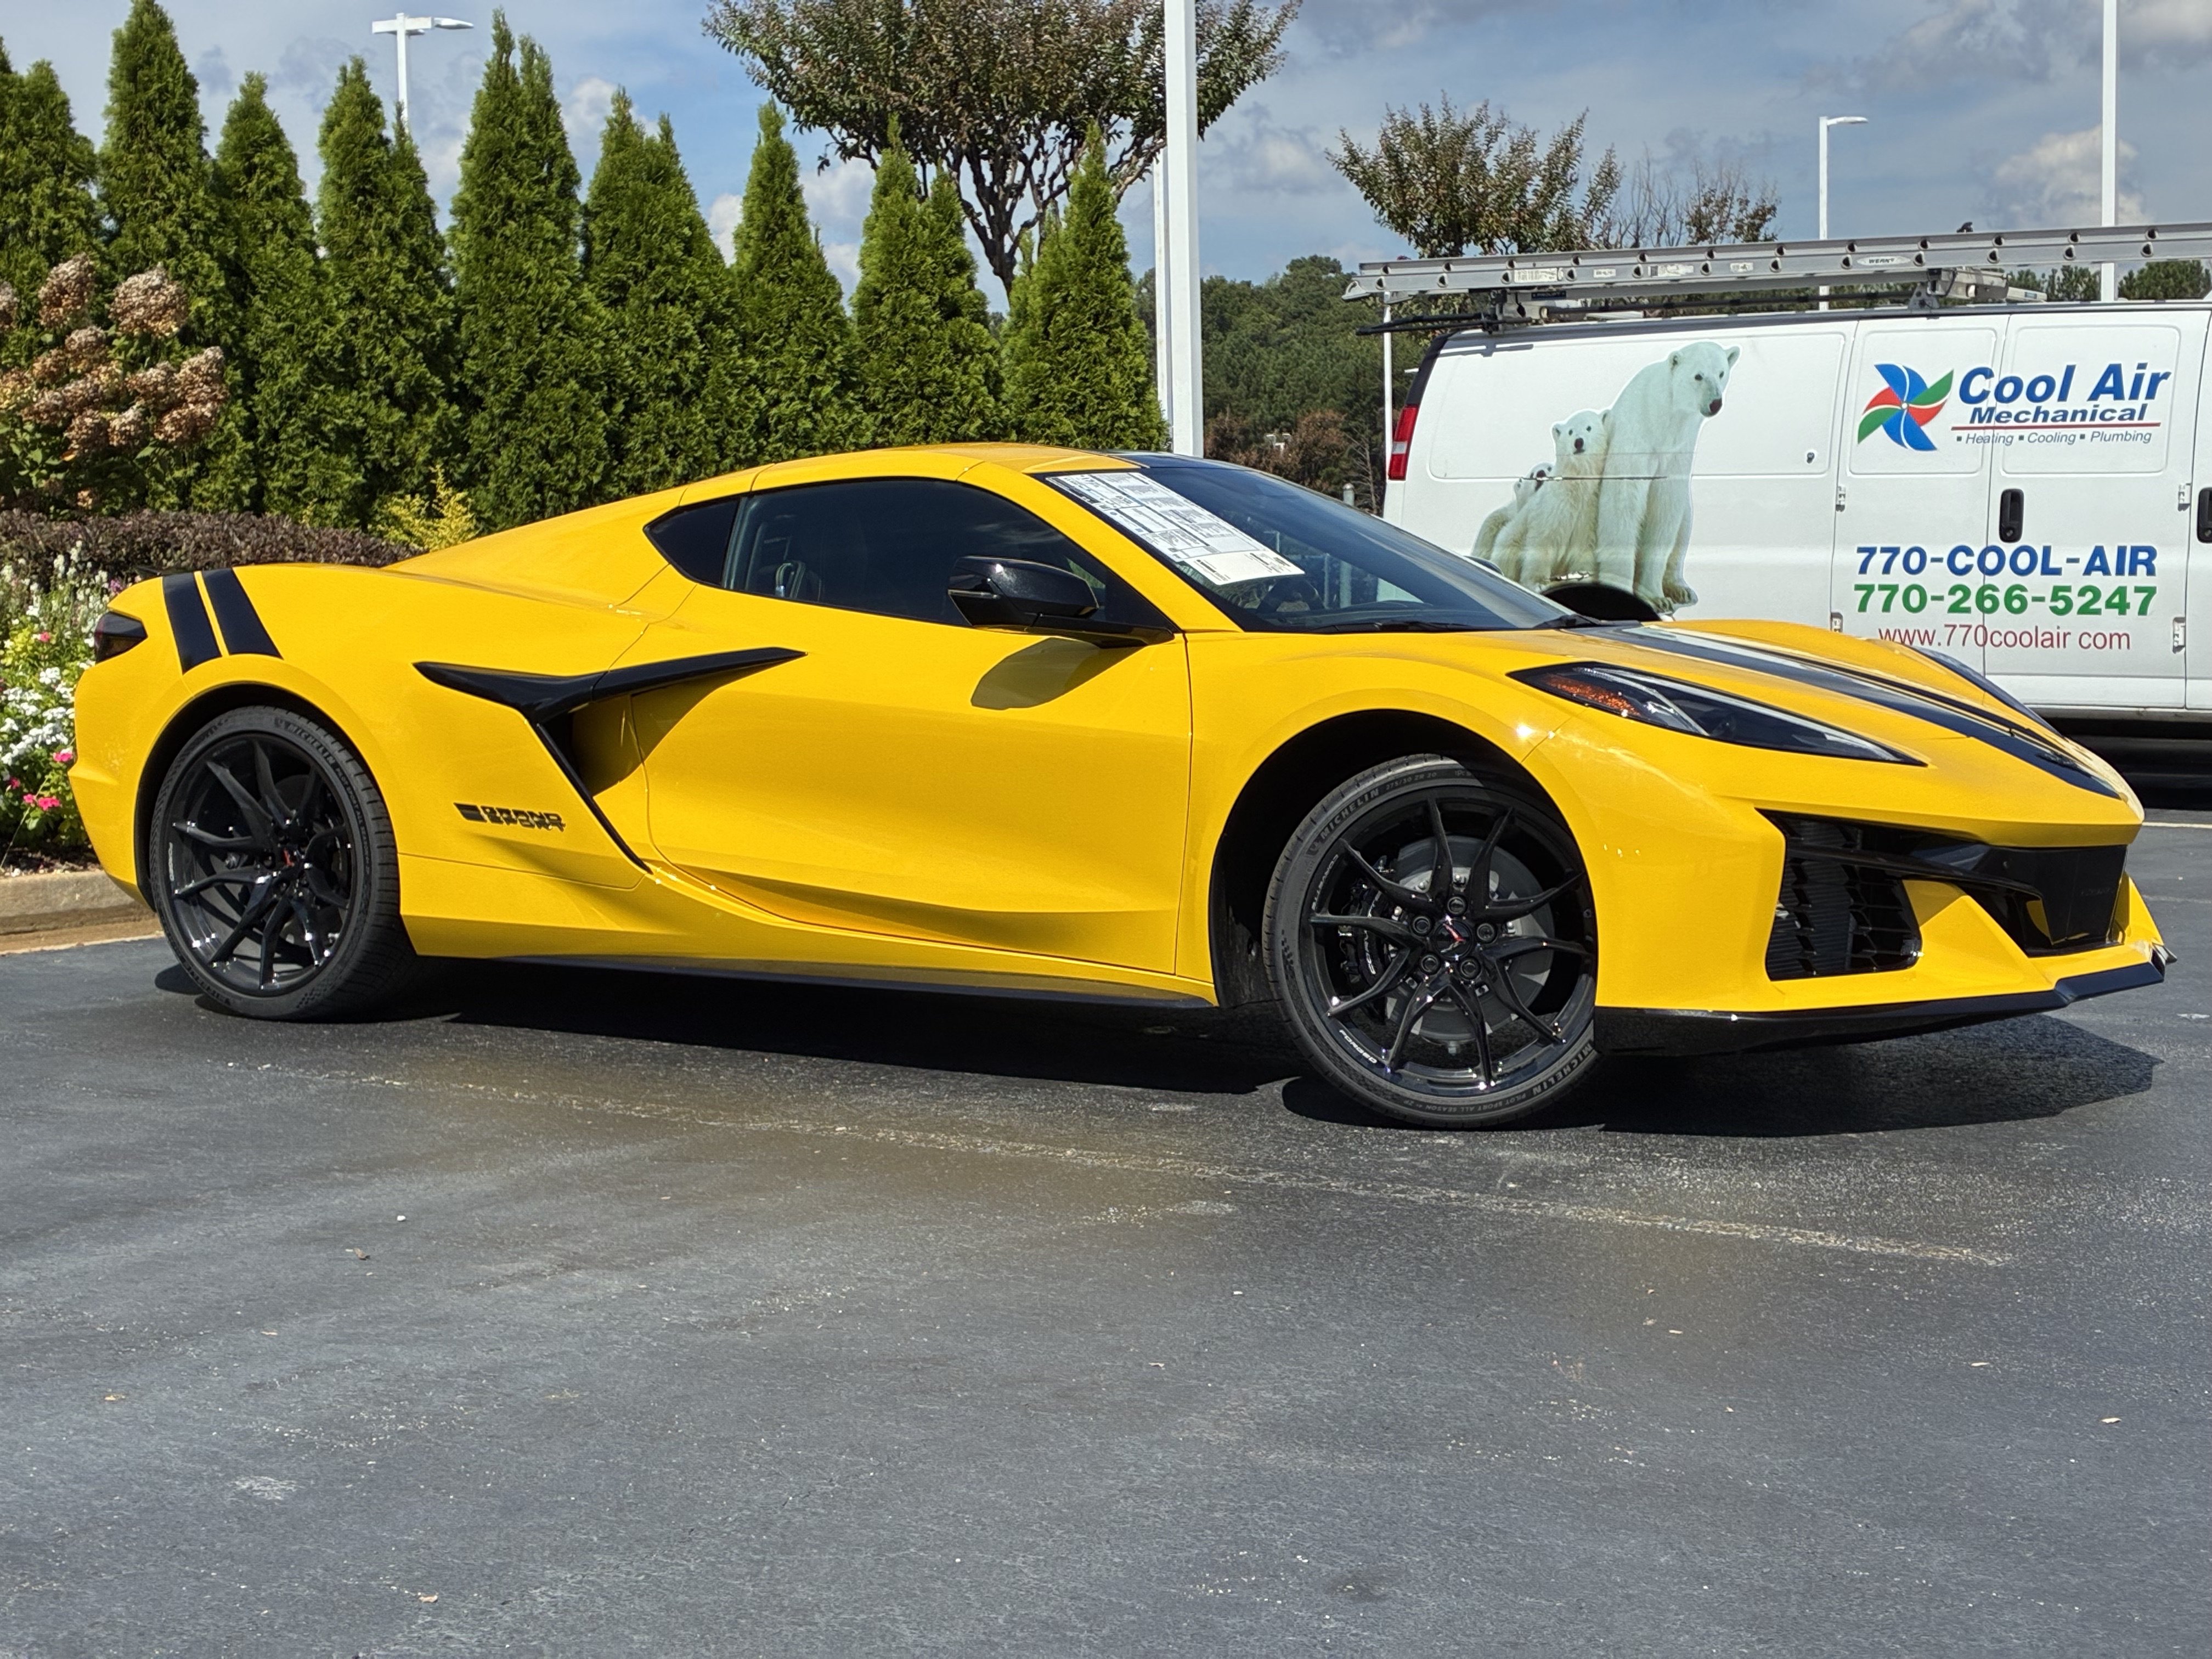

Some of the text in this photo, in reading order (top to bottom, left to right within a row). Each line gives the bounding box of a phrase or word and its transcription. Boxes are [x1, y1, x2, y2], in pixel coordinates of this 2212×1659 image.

[1959, 363, 2171, 404] Cool Air
[1970, 403, 2148, 424] Mechanical
[1965, 431, 2152, 445] Heating Cooling Plumbing
[1857, 545, 2157, 576] 770-COOL-AIR
[1854, 584, 2157, 615] 770-266-5247
[286, 724, 336, 764] MICHELIN
[1321, 788, 1379, 839] MICHELIN
[1339, 1030, 1377, 1063] FORGED
[1532, 1043, 1593, 1095] MICHELIN
[1477, 1099, 1502, 1111] SPORT
[1505, 1093, 1526, 1105] PILOT
